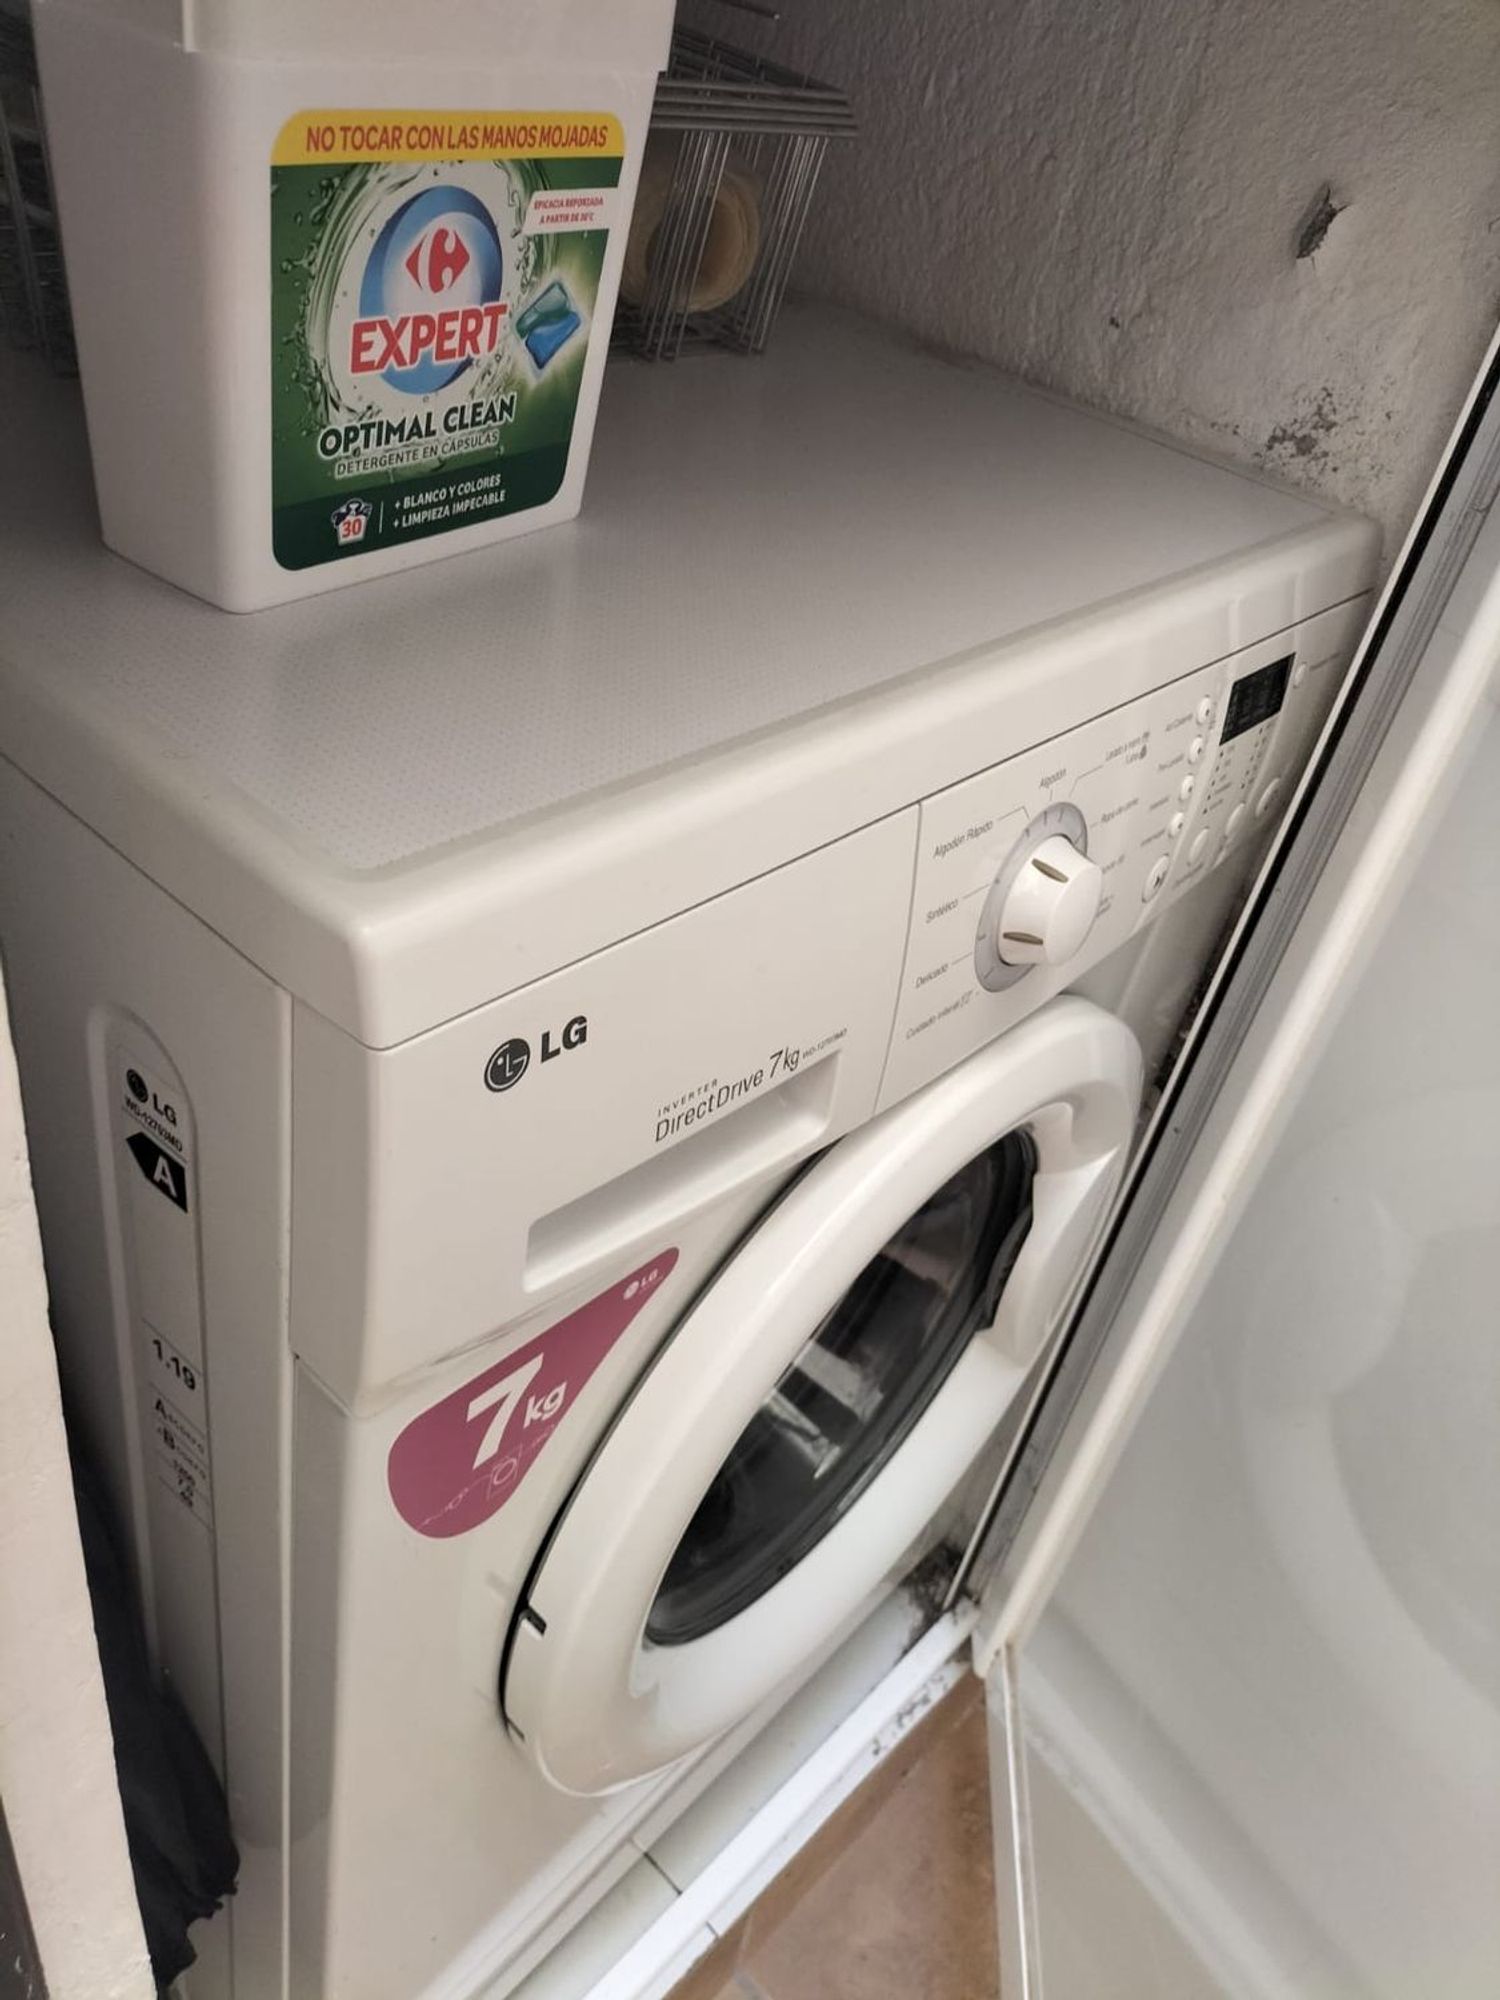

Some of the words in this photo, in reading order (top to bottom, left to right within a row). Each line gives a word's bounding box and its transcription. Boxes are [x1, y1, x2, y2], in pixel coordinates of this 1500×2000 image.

[306, 125, 335, 151] NO
[340, 125, 402, 151] TOCAR
[405, 125, 442, 150] CON
[447, 125, 479, 150] LAS
[481, 125, 536, 149] MANOS
[539, 125, 608, 148] MOJADAS
[351, 303, 508, 375] EXPERT
[320, 412, 437, 456] OPTIMAL
[442, 394, 518, 434] CLEAN
[336, 448, 419, 477] DETERGENTE
[422, 445, 439, 460] EN
[440, 430, 499, 457] CÁPSULAS
[402, 508, 450, 528] LIMPIEZA
[451, 490, 507, 517] IMPECABLE
[403, 488, 447, 510] BLANCO
[448, 485, 457, 499] Y
[457, 474, 502, 496] COLORES
[341, 517, 363, 539] 30
[932, 832, 966, 859] Algodón
[965, 819, 994, 842] Rápido
[541, 1014, 588, 1063] LG
[153, 1092, 177, 1128] LG
[657, 1077, 718, 1118] INVERTER
[153, 1154, 178, 1199] A
[640, 1268, 659, 1288] LG
